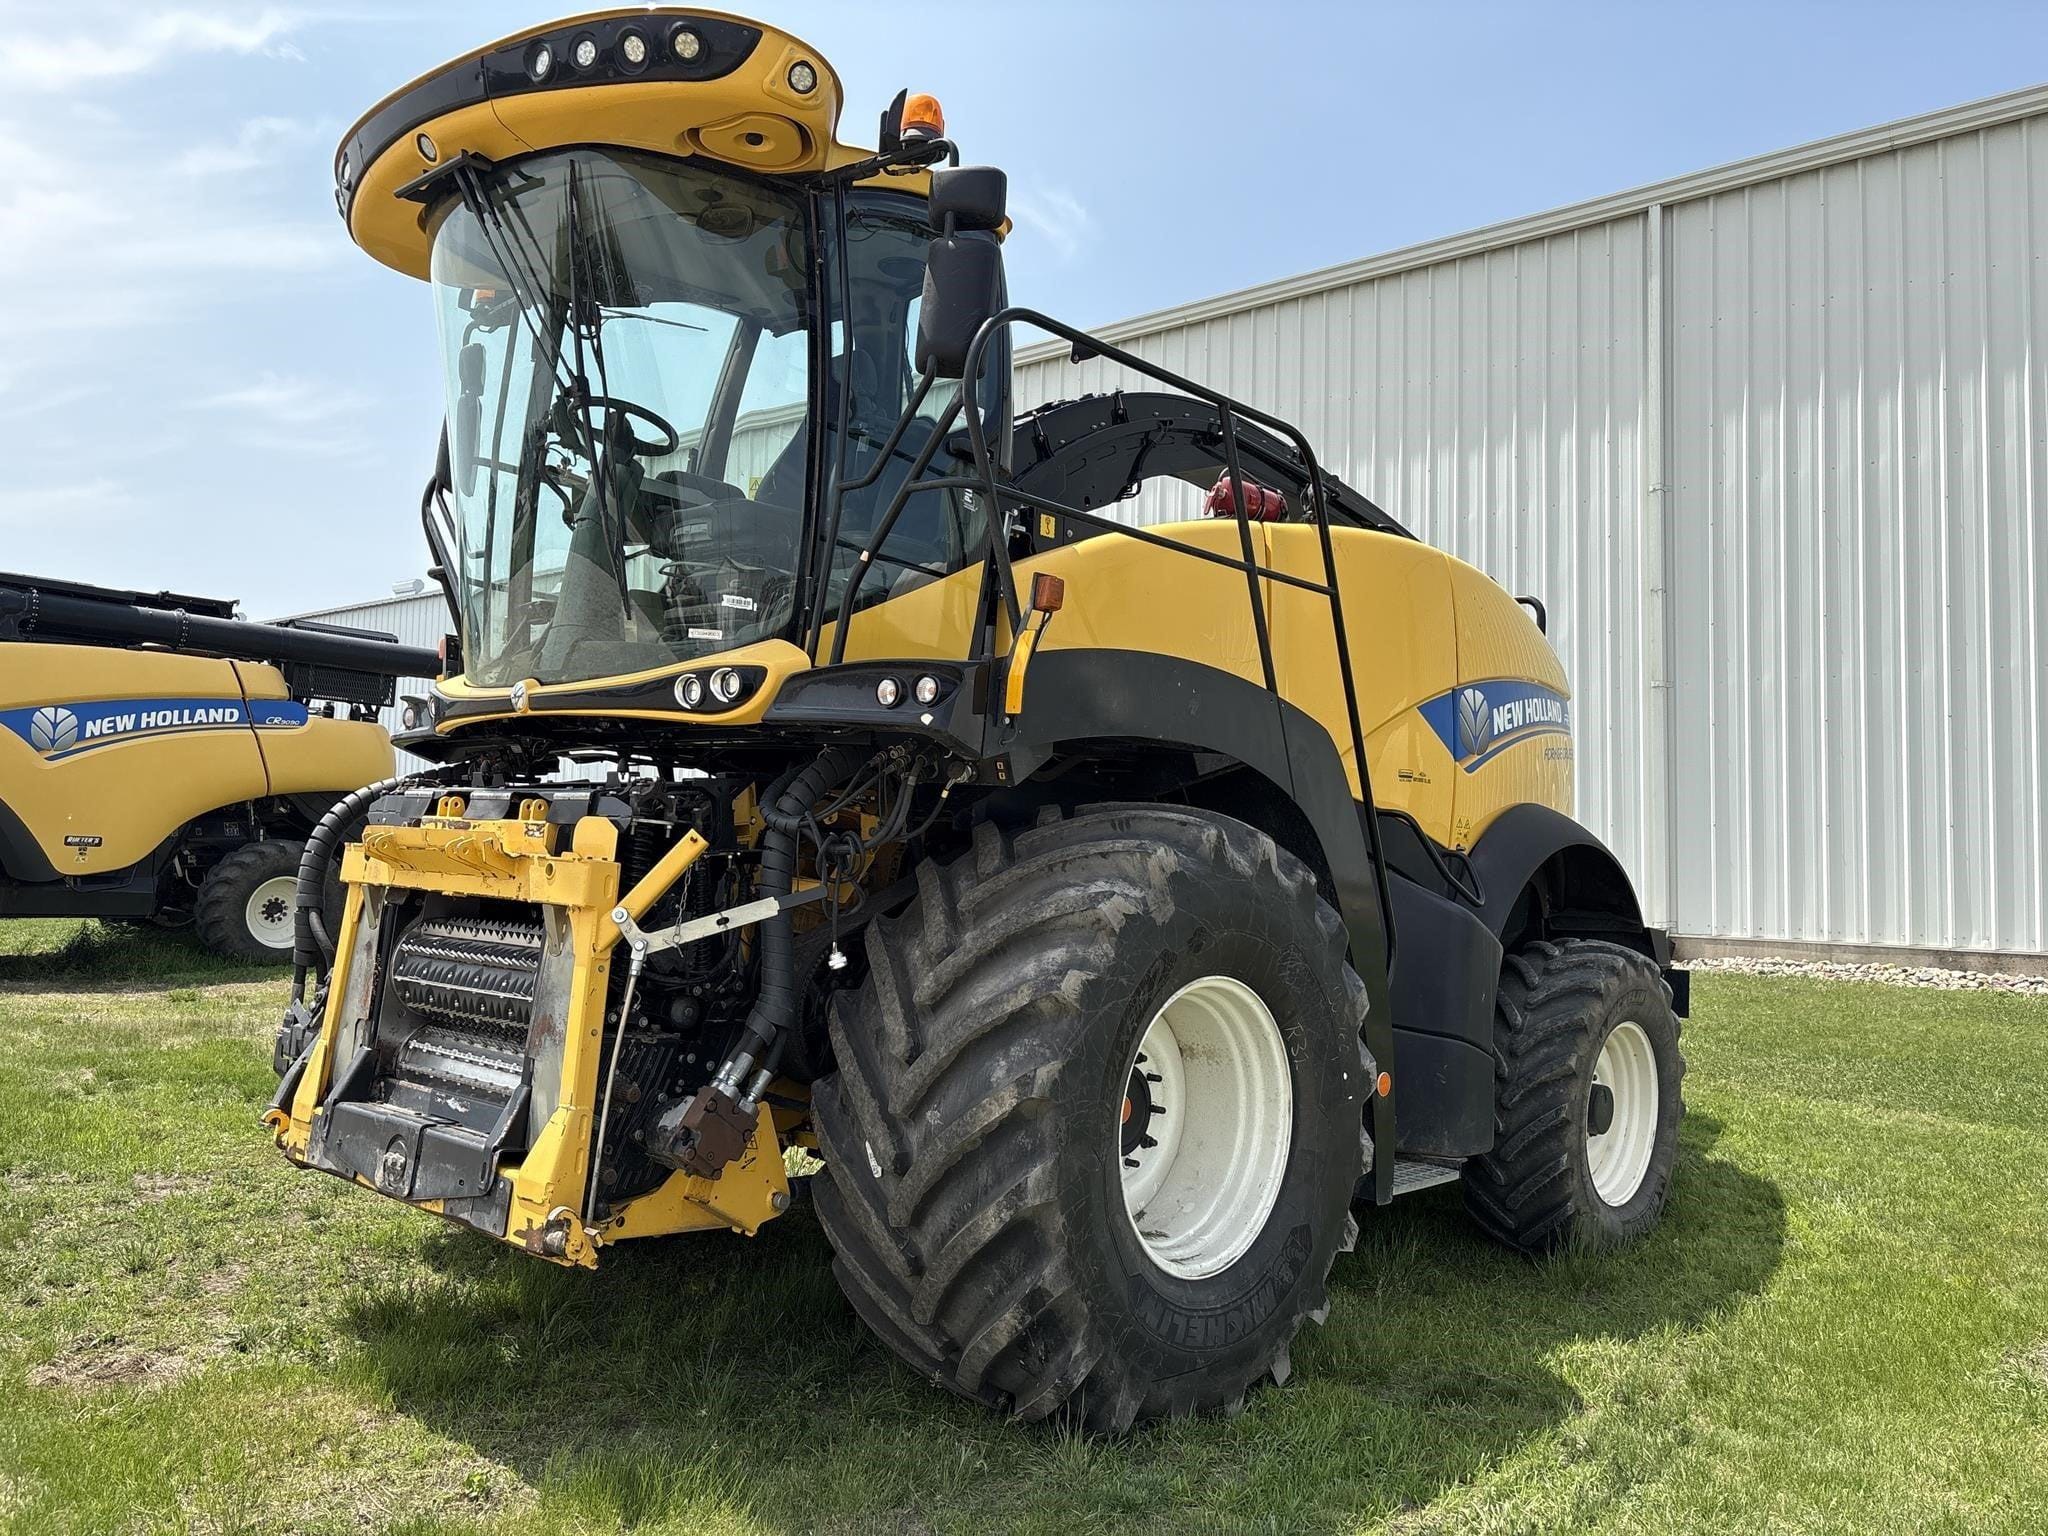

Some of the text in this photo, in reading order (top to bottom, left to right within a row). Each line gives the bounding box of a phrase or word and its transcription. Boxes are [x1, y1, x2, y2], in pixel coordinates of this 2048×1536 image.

[85, 708, 239, 737] NEW HOLLAND
[1493, 698, 1562, 735] NEW HOLLAND
